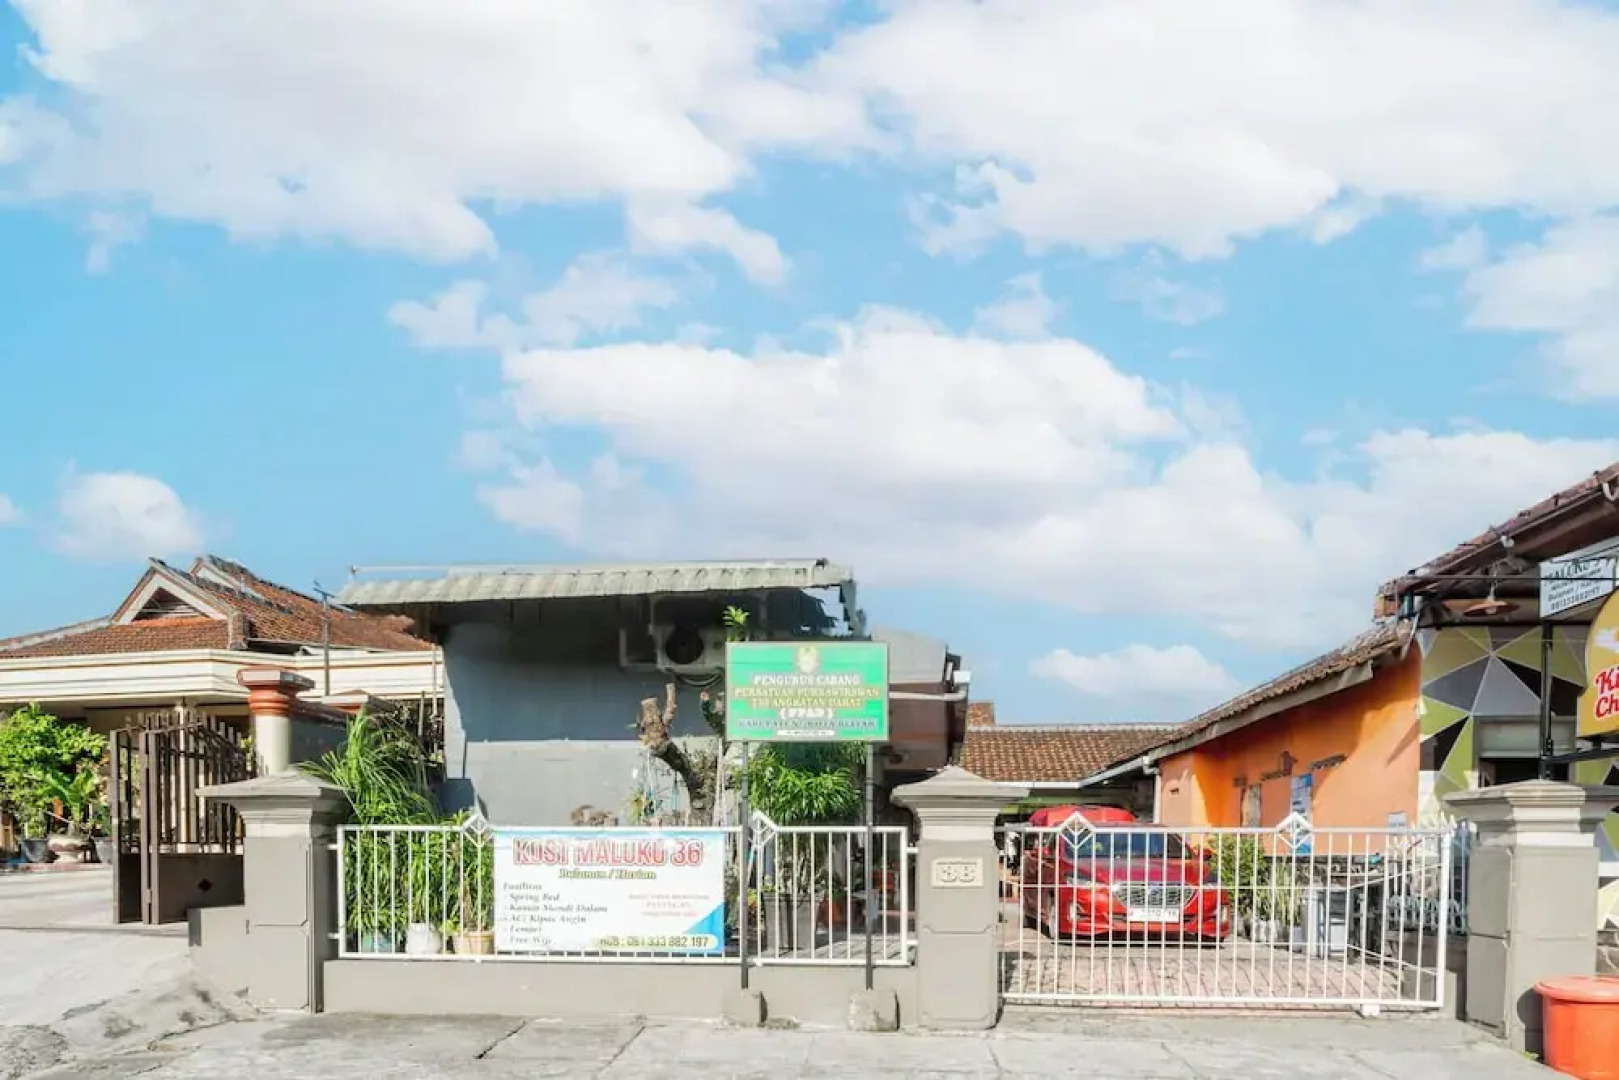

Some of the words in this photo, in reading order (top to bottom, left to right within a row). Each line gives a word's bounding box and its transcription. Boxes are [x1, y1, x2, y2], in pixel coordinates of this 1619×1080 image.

[816, 674, 861, 686] CABANG
[574, 837, 667, 866] MALUKU
[671, 839, 704, 866] 36
[691, 936, 709, 948] 197
